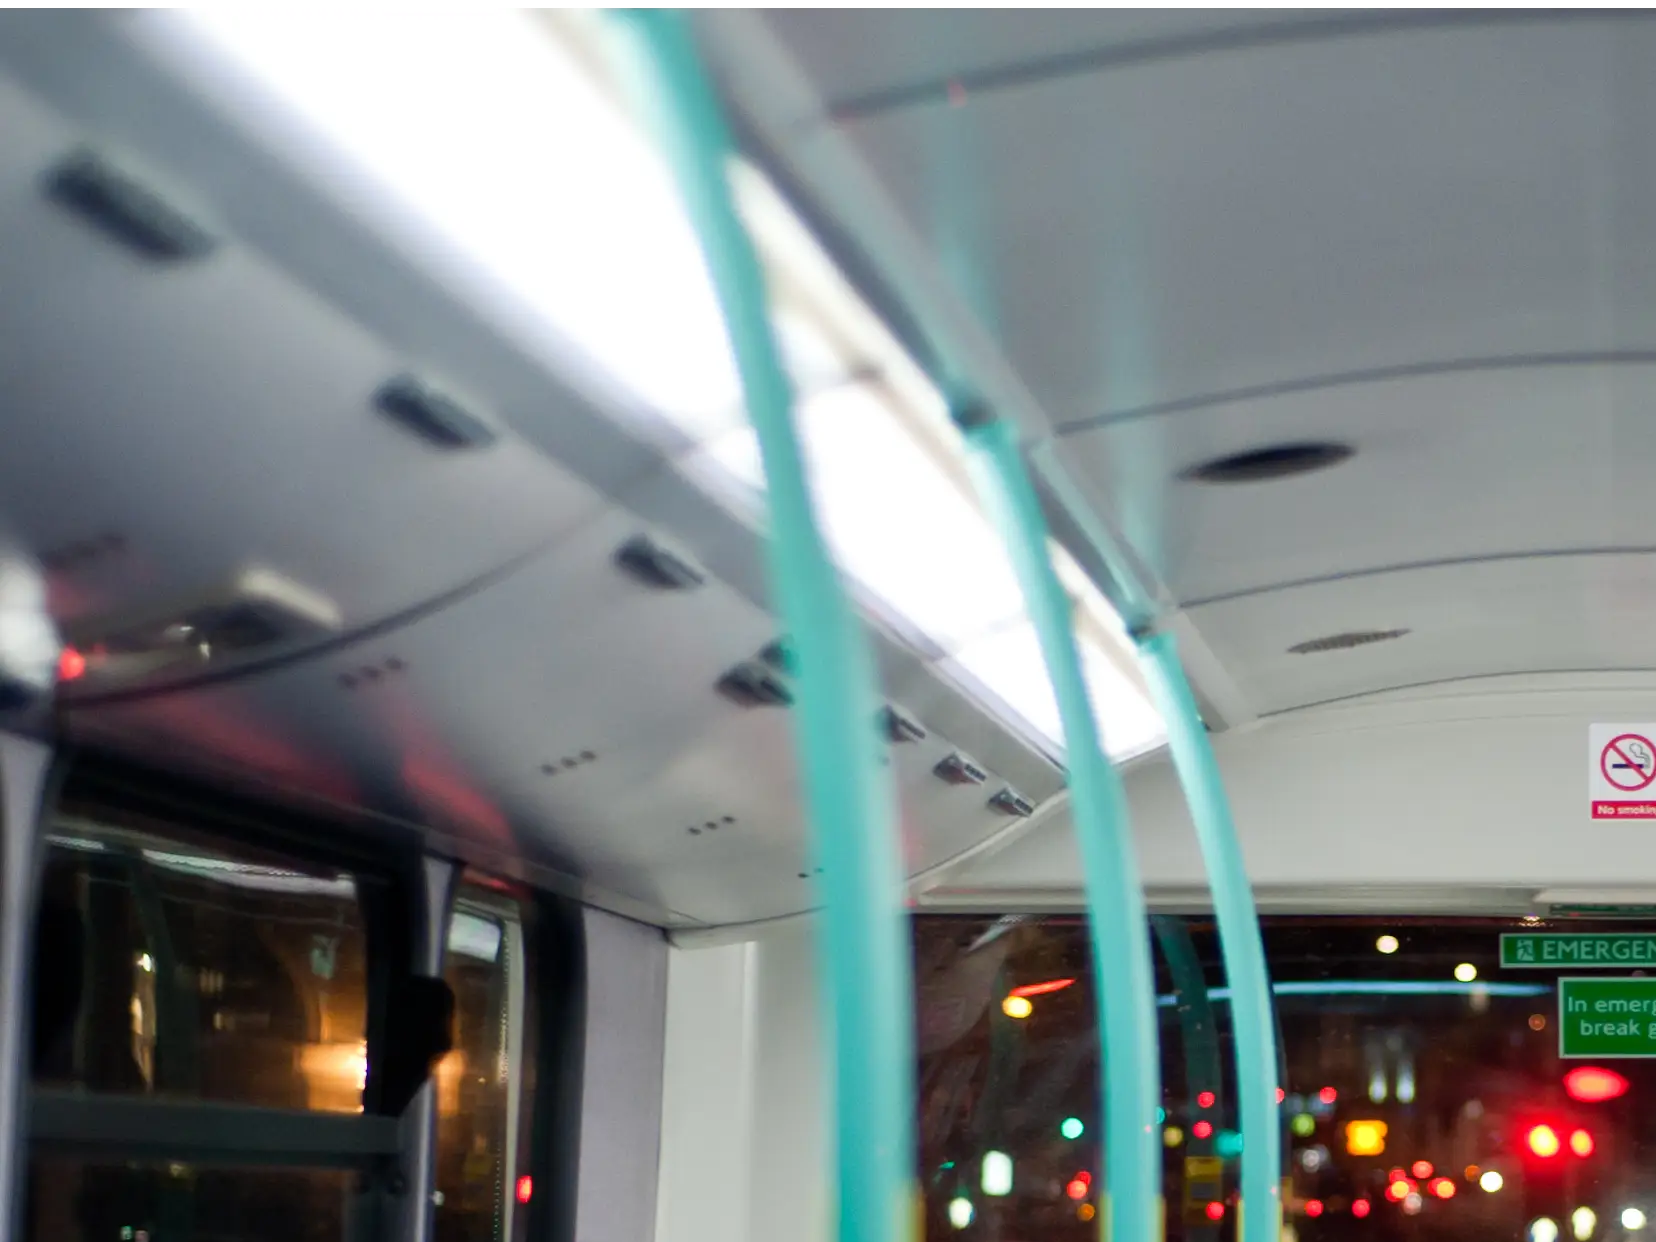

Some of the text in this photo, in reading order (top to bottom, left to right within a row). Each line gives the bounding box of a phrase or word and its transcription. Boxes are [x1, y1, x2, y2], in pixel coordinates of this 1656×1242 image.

[1597, 805, 1615, 815] No
[1568, 996, 1588, 1013] In
[1580, 1018, 1640, 1036] break
